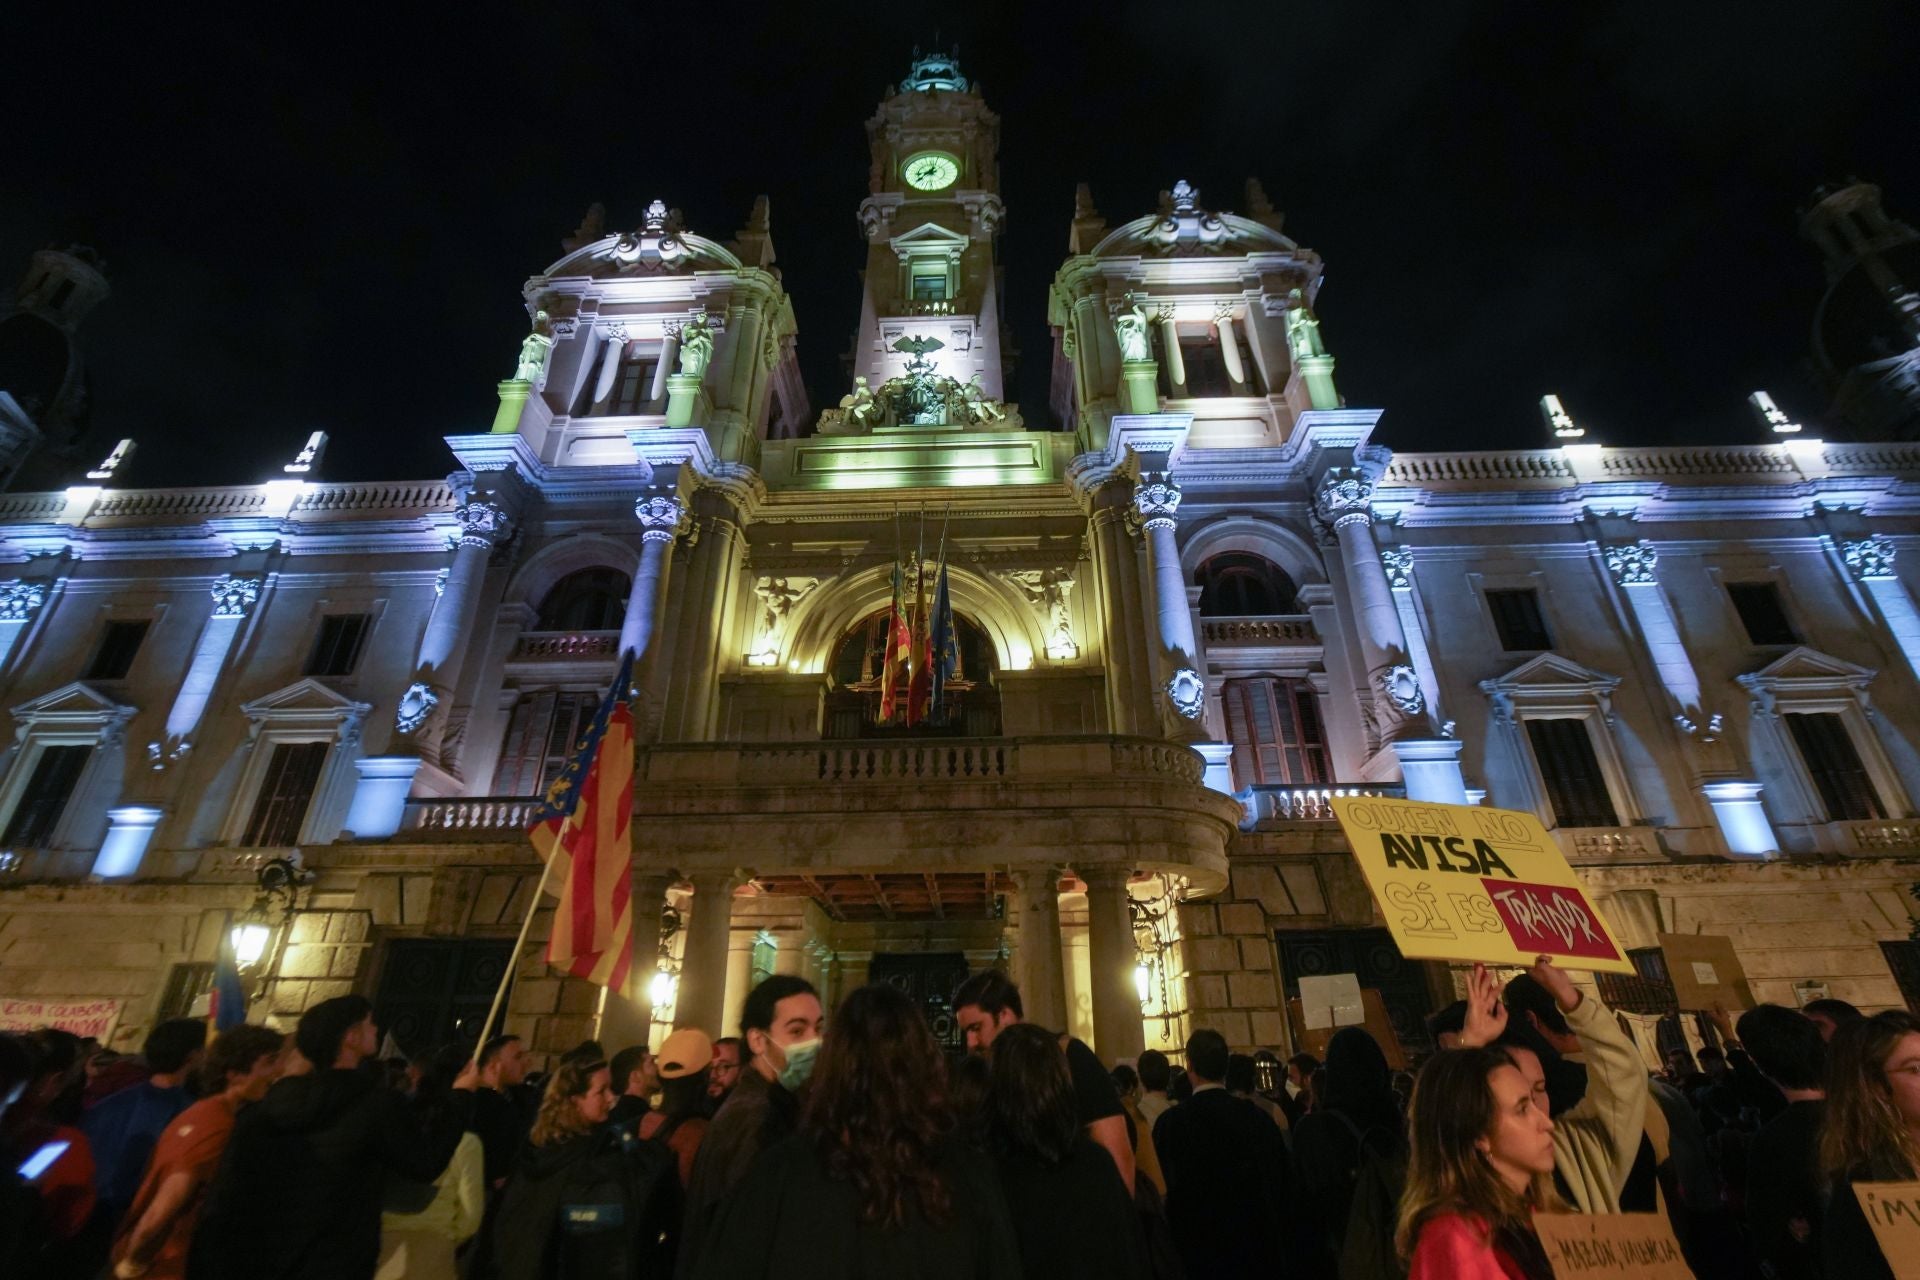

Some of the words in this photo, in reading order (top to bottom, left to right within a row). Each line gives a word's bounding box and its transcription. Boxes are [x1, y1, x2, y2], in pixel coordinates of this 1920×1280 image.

[1347, 802, 1463, 836] QUIEN
[1472, 810, 1532, 843] NO
[1380, 833, 1518, 879] AVISA
[1384, 881, 1452, 932] SÍ
[1447, 892, 1504, 934] ES
